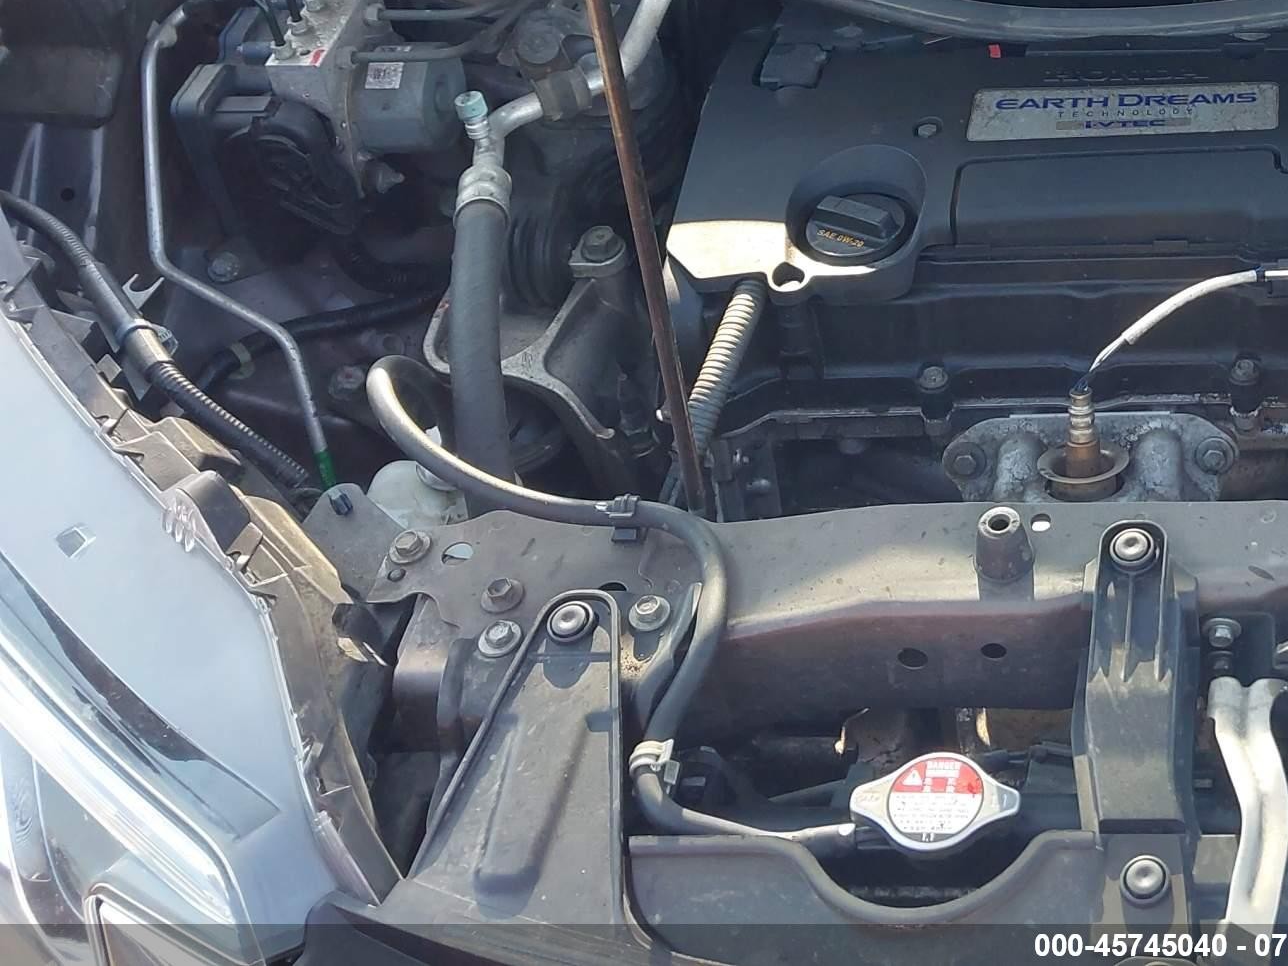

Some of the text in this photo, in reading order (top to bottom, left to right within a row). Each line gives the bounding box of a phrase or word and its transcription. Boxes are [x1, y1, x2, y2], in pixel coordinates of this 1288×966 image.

[995, 92, 1258, 110] EARTH DREAMS
[816, 229, 865, 248] SAE 0W-20
